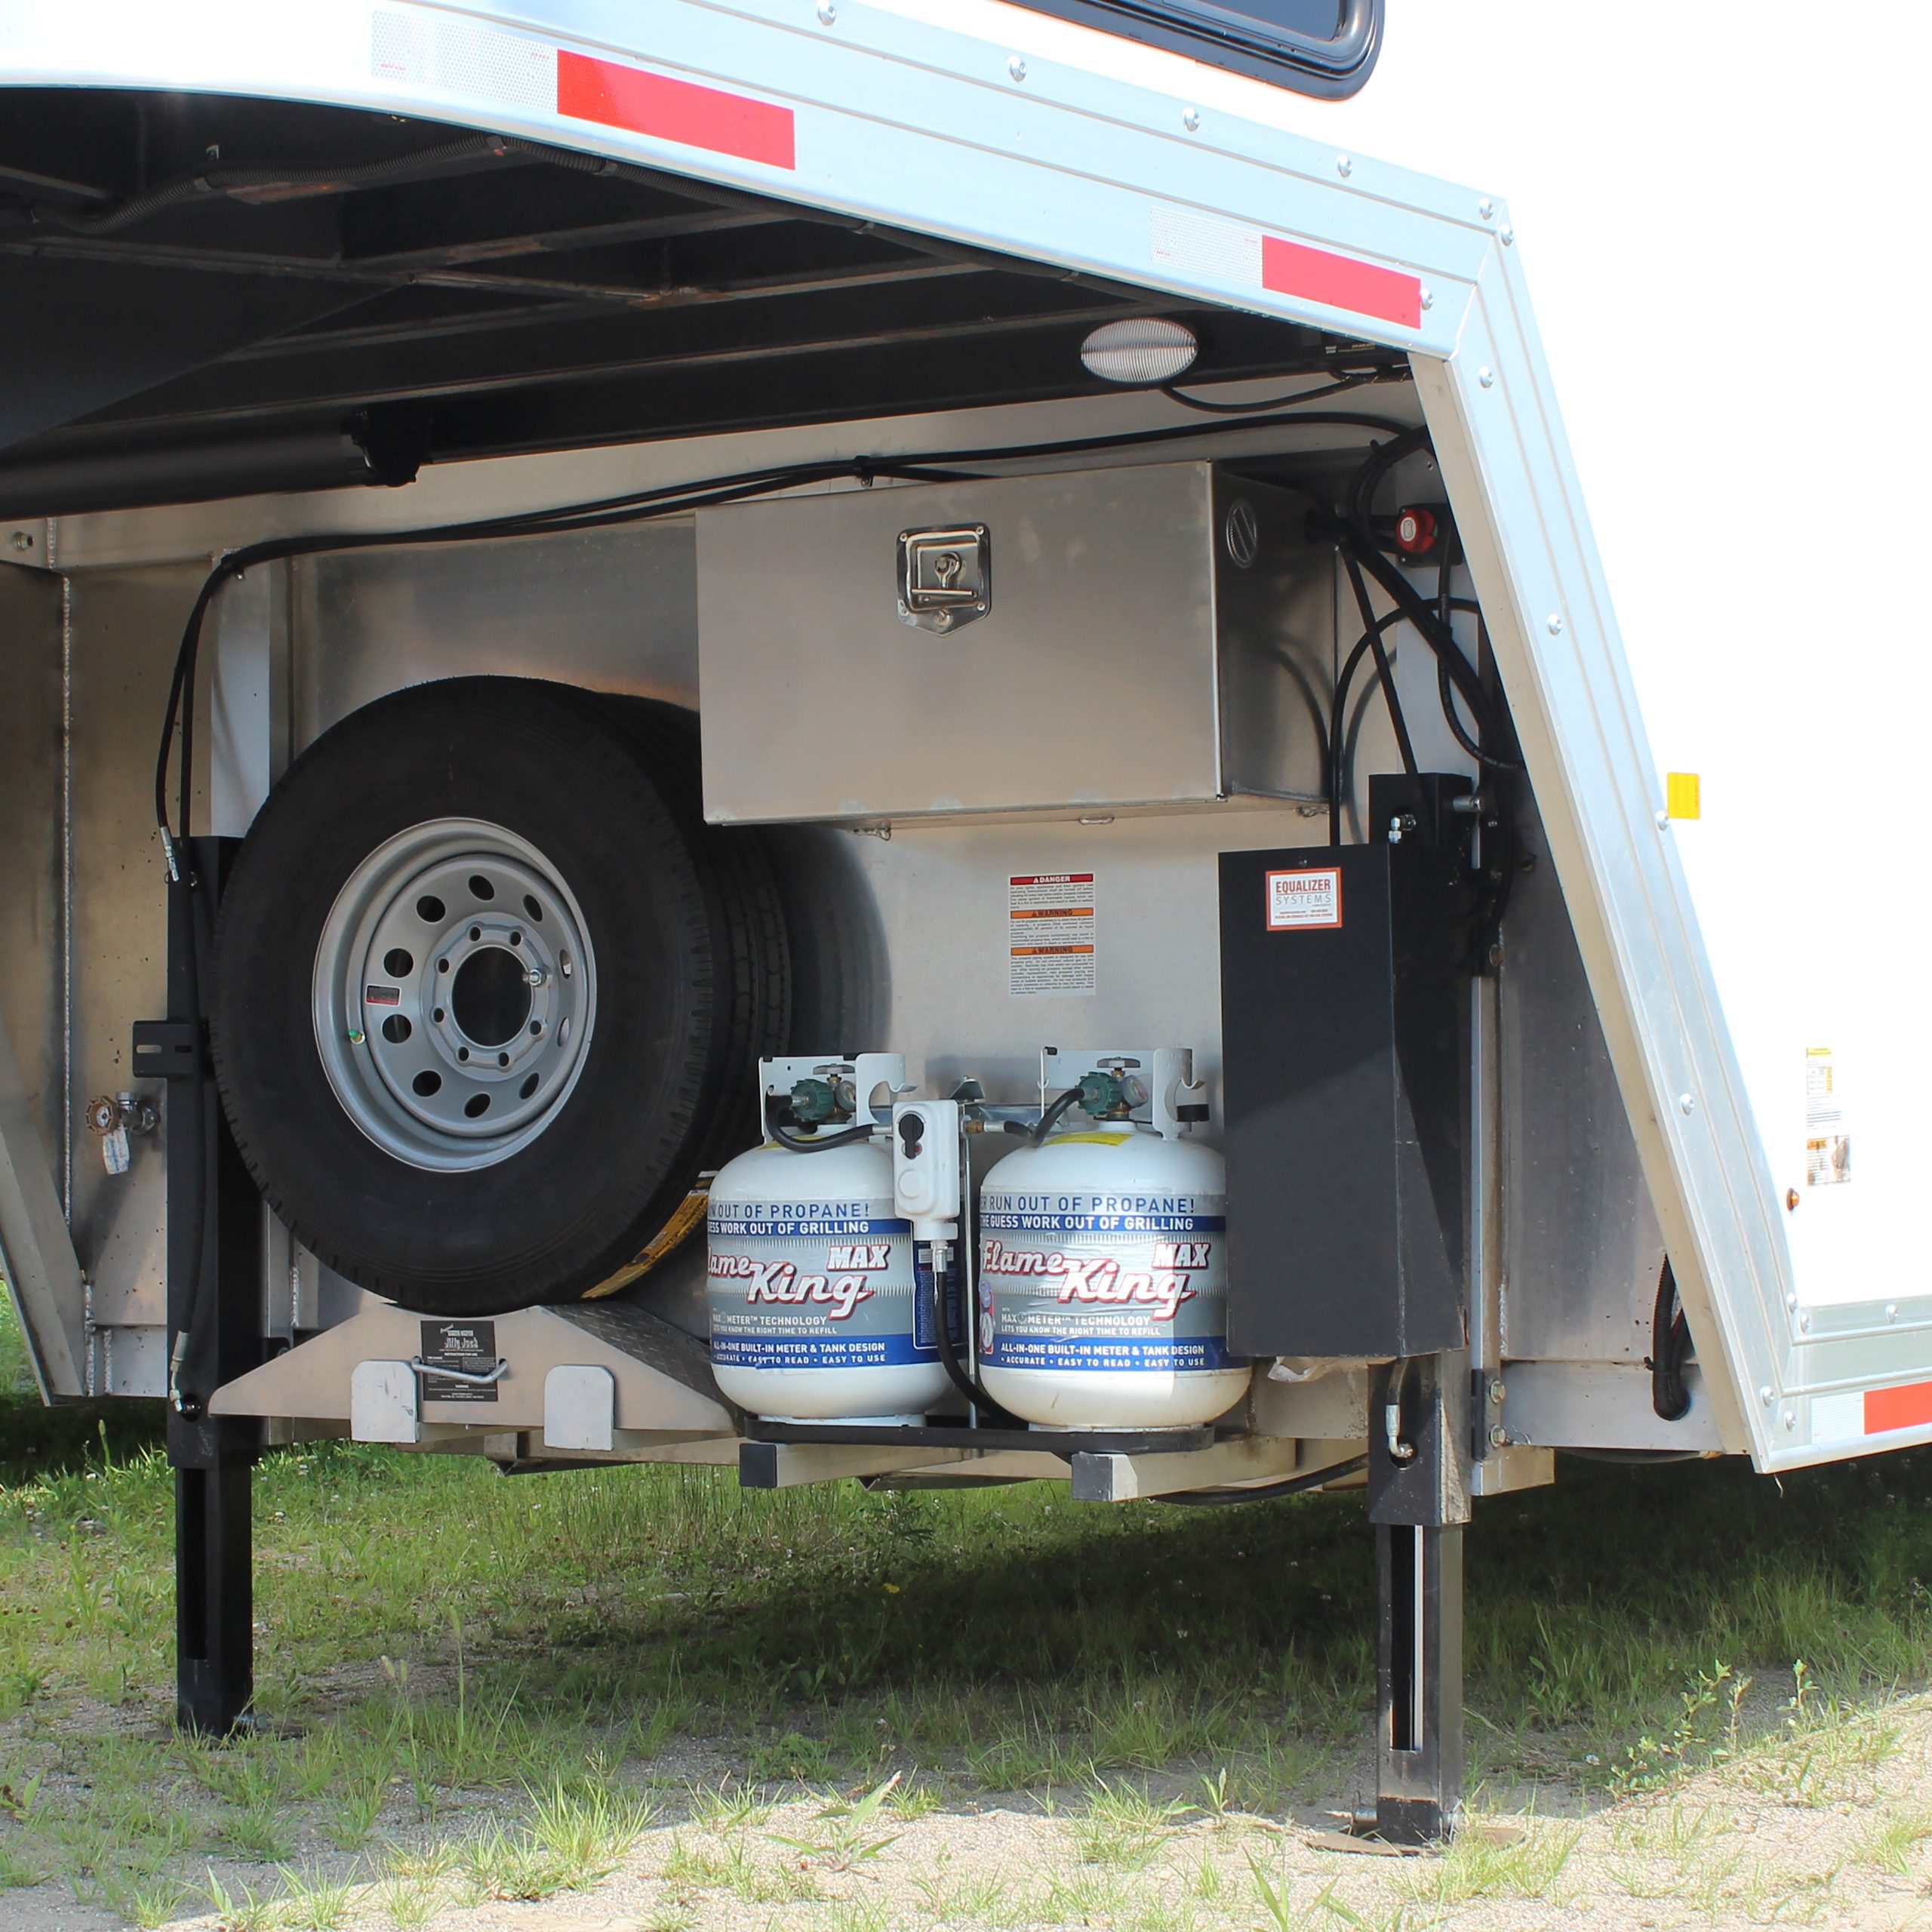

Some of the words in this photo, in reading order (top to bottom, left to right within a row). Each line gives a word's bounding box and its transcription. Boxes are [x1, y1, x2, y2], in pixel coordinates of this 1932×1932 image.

[1275, 878, 1331, 894] EQUALIZER
[1275, 894, 1331, 906] SYSTEMS
[718, 1204, 740, 1218] OUT
[744, 1204, 763, 1219] OF
[770, 1203, 869, 1219] PROPANE!
[989, 1196, 1011, 1211] RUN
[1017, 1196, 1050, 1211] OUT
[1057, 1197, 1083, 1212] OF
[1091, 1197, 1195, 1214] PROPANE!
[720, 1222, 747, 1235] WORK
[749, 1222, 774, 1235] OUT
[777, 1222, 795, 1235] OF
[798, 1220, 869, 1235] GRILLING
[989, 1215, 1019, 1229] GUESS
[1021, 1216, 1060, 1229] WORK
[1064, 1216, 1095, 1229] OUT
[1099, 1217, 1121, 1230] OF
[1124, 1217, 1195, 1231] GRILLING
[826, 1244, 891, 1271] MAX
[1151, 1242, 1211, 1269] MAX
[983, 1241, 1065, 1276] Flame
[1056, 1258, 1197, 1321] King
[746, 1261, 875, 1320] King
[759, 1315, 827, 1327] TECHNOLOGY
[1075, 1315, 1151, 1327] TECHNOLOGY
[1016, 1325, 1029, 1334] YOU
[1029, 1326, 1051, 1334] KNOW
[1051, 1327, 1068, 1335] THE
[1096, 1327, 1118, 1336] TIME
[1118, 1327, 1130, 1336] TO
[1131, 1327, 1161, 1336] REFILL
[741, 1343, 773, 1352] BUILT-IN
[776, 1343, 807, 1353] METER
[810, 1344, 817, 1353] &
[820, 1343, 847, 1353] TANK
[849, 1343, 885, 1352] DESIGN
[1001, 1343, 1046, 1355] ALL-IN-ONE
[1048, 1345, 1091, 1355] BUILT-IN
[1094, 1345, 1130, 1356] METER
[1132, 1346, 1140, 1356] &
[1142, 1346, 1171, 1356] TANK
[1171, 1345, 1204, 1355] DESIGN
[784, 1356, 810, 1364] READ
[867, 1354, 886, 1362] USE
[1006, 1355, 1046, 1365] ACCURATE
[1057, 1357, 1082, 1367] EASY
[1087, 1358, 1099, 1367] TO
[1103, 1358, 1131, 1367] READ
[1144, 1358, 1170, 1367] EASY
[1174, 1358, 1185, 1366] TO
[1188, 1357, 1204, 1366] USE
